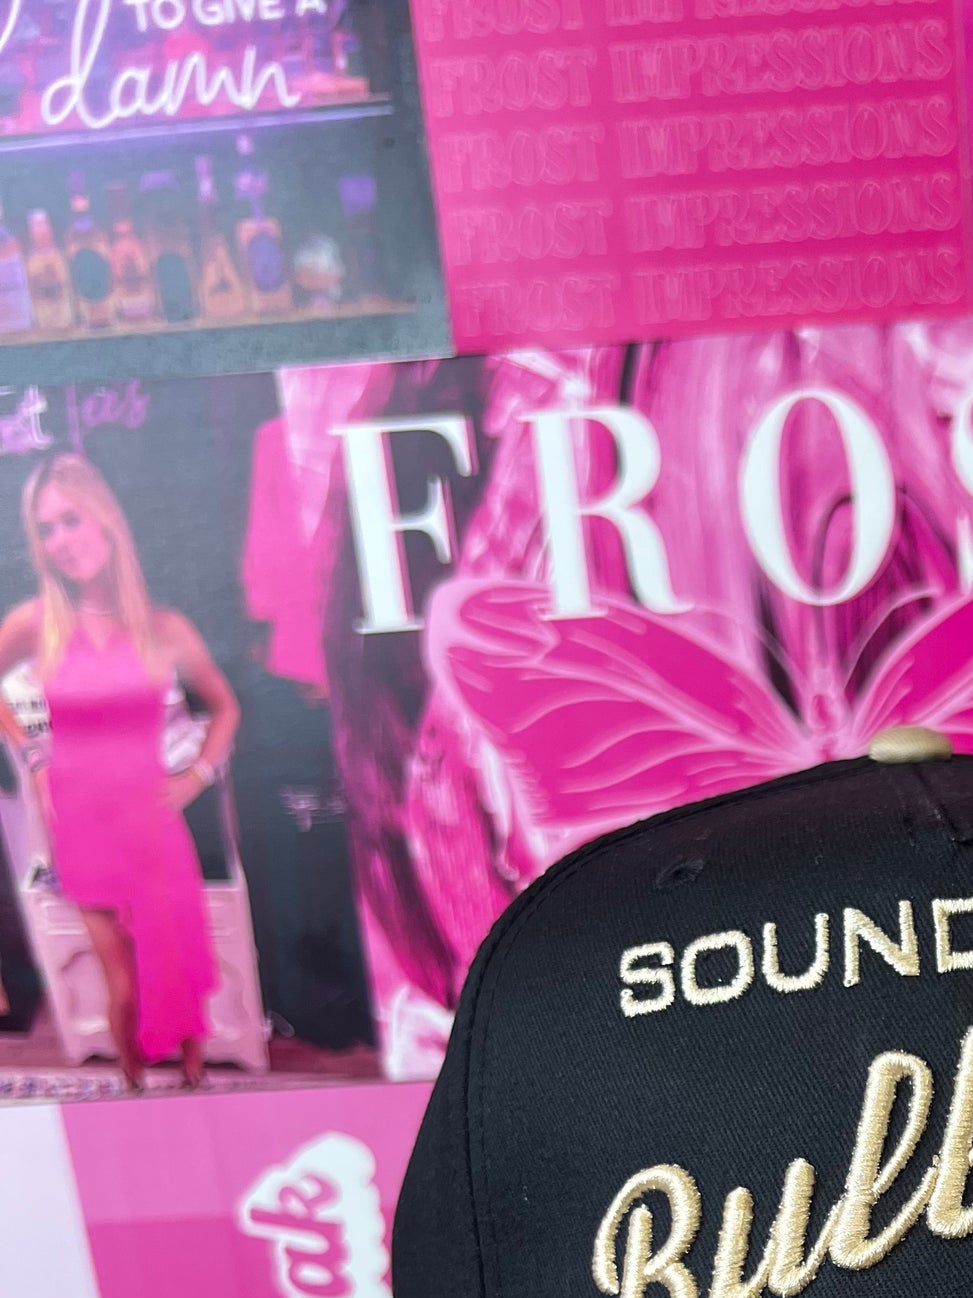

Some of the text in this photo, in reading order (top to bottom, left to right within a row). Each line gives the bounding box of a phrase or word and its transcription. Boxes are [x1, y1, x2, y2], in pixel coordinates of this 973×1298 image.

[41, 0, 301, 129] damn
[124, 0, 188, 31] TO
[190, 0, 285, 25] GIVE
[429, 17, 953, 118] FROST IMPRESSIONS
[439, 93, 958, 193] FROST IMPRESSIONS
[447, 170, 962, 267] FROST IMPRESSIONS
[461, 246, 967, 338] FROST IMPRESSIONS
